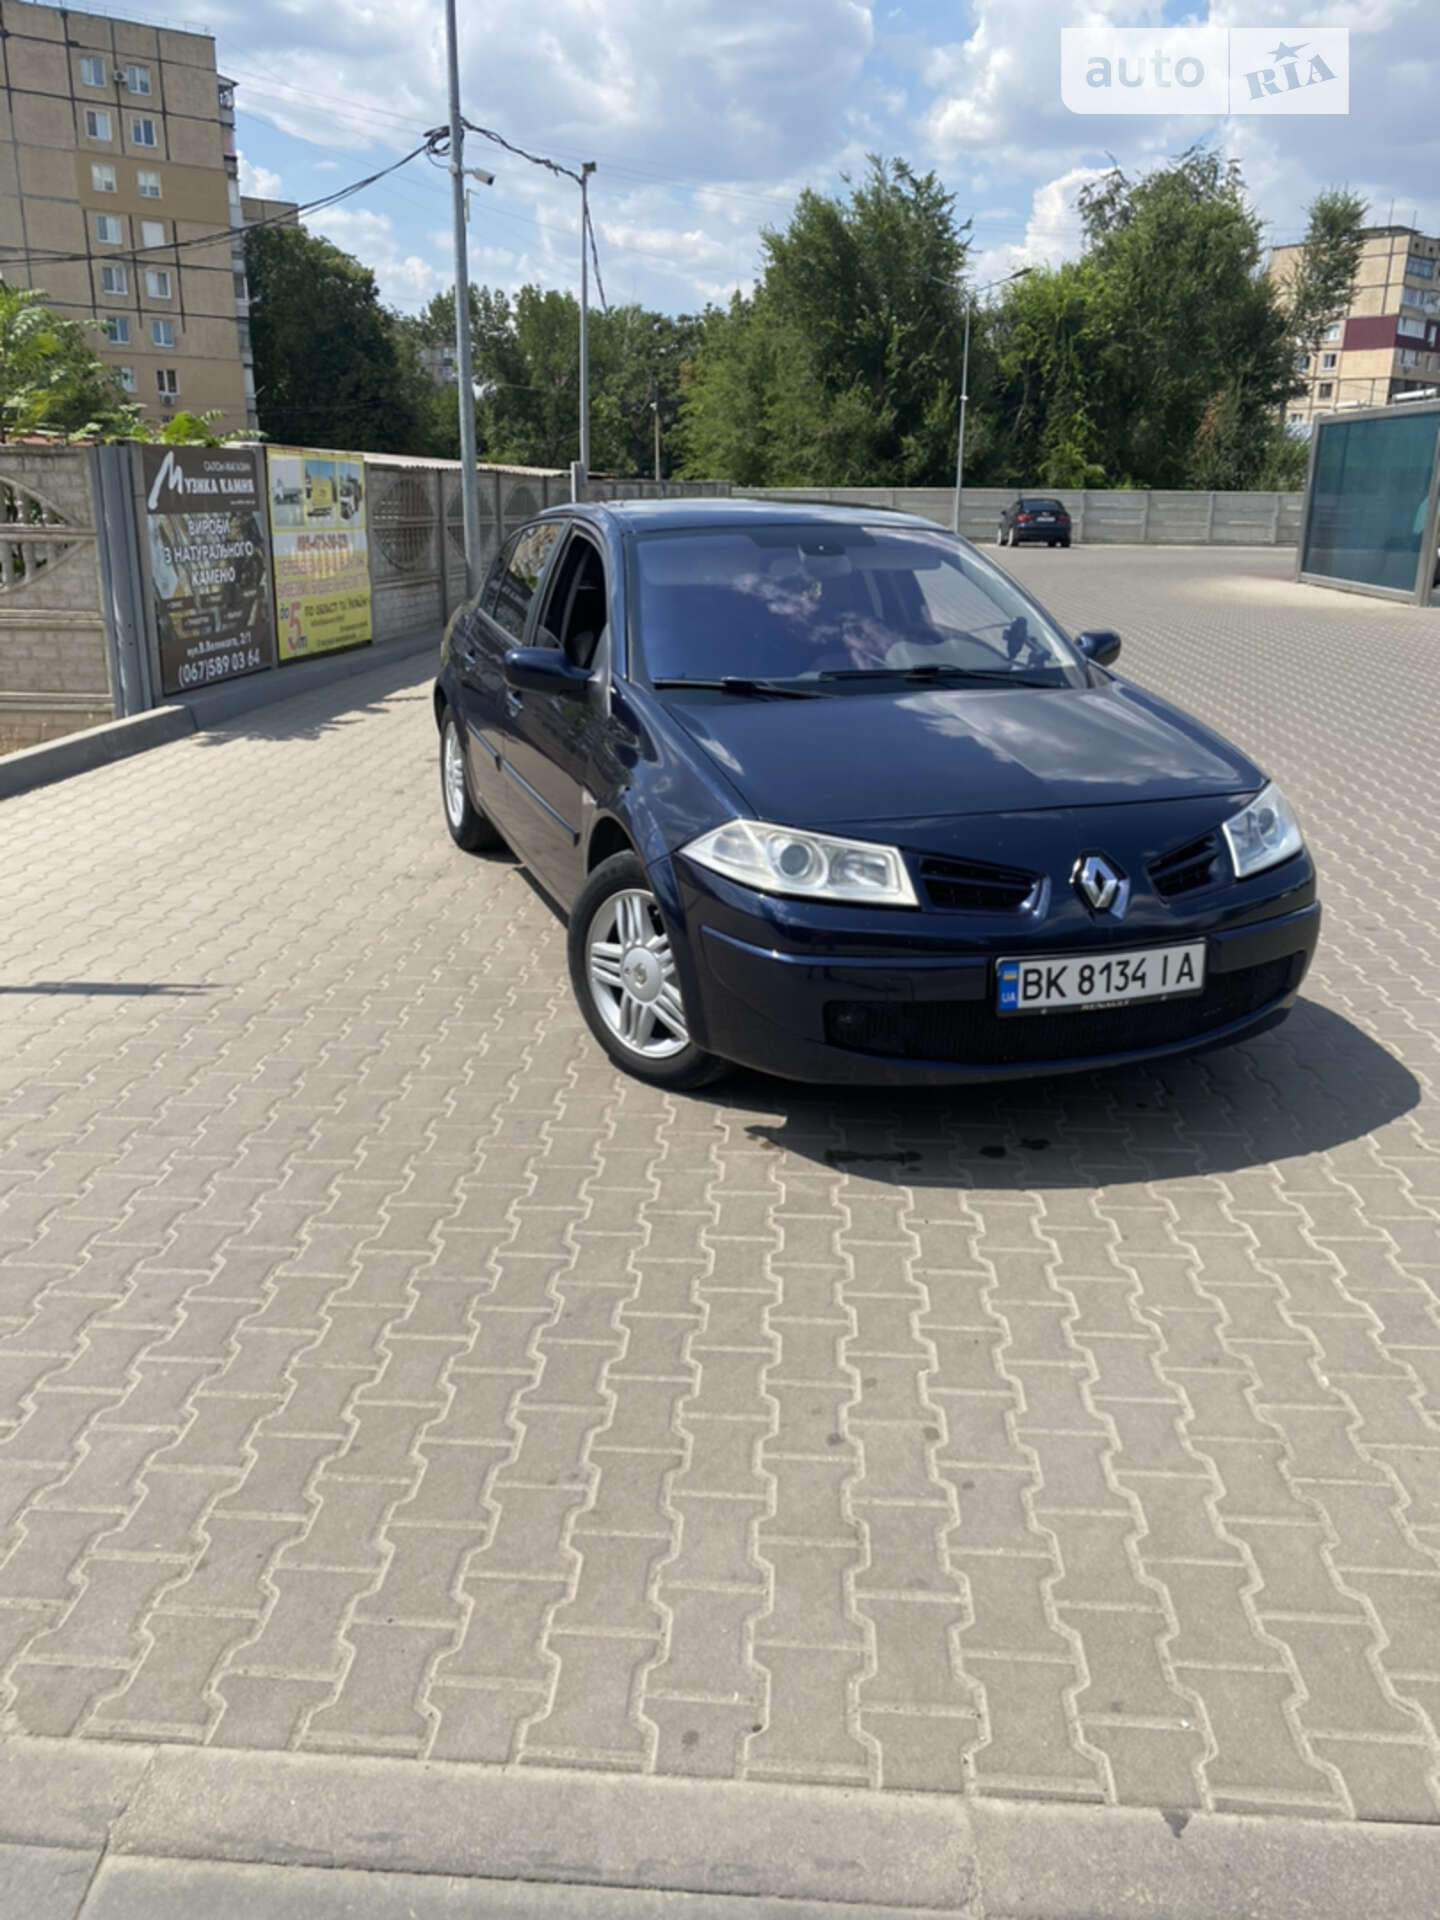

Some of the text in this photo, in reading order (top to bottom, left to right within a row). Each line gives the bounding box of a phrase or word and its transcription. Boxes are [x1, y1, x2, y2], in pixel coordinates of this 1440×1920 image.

[188, 519, 231, 536] ВИРОБИ
[174, 541, 254, 564] НАТУРАЛЬНОГО
[191, 566, 236, 587] КАМЕНЮ
[287, 601, 302, 650] 5
[179, 647, 260, 688] (067)589 03 64
[1022, 965, 1068, 1001] BK
[1077, 957, 1147, 996] 8134
[1002, 993, 1017, 1003] UA
